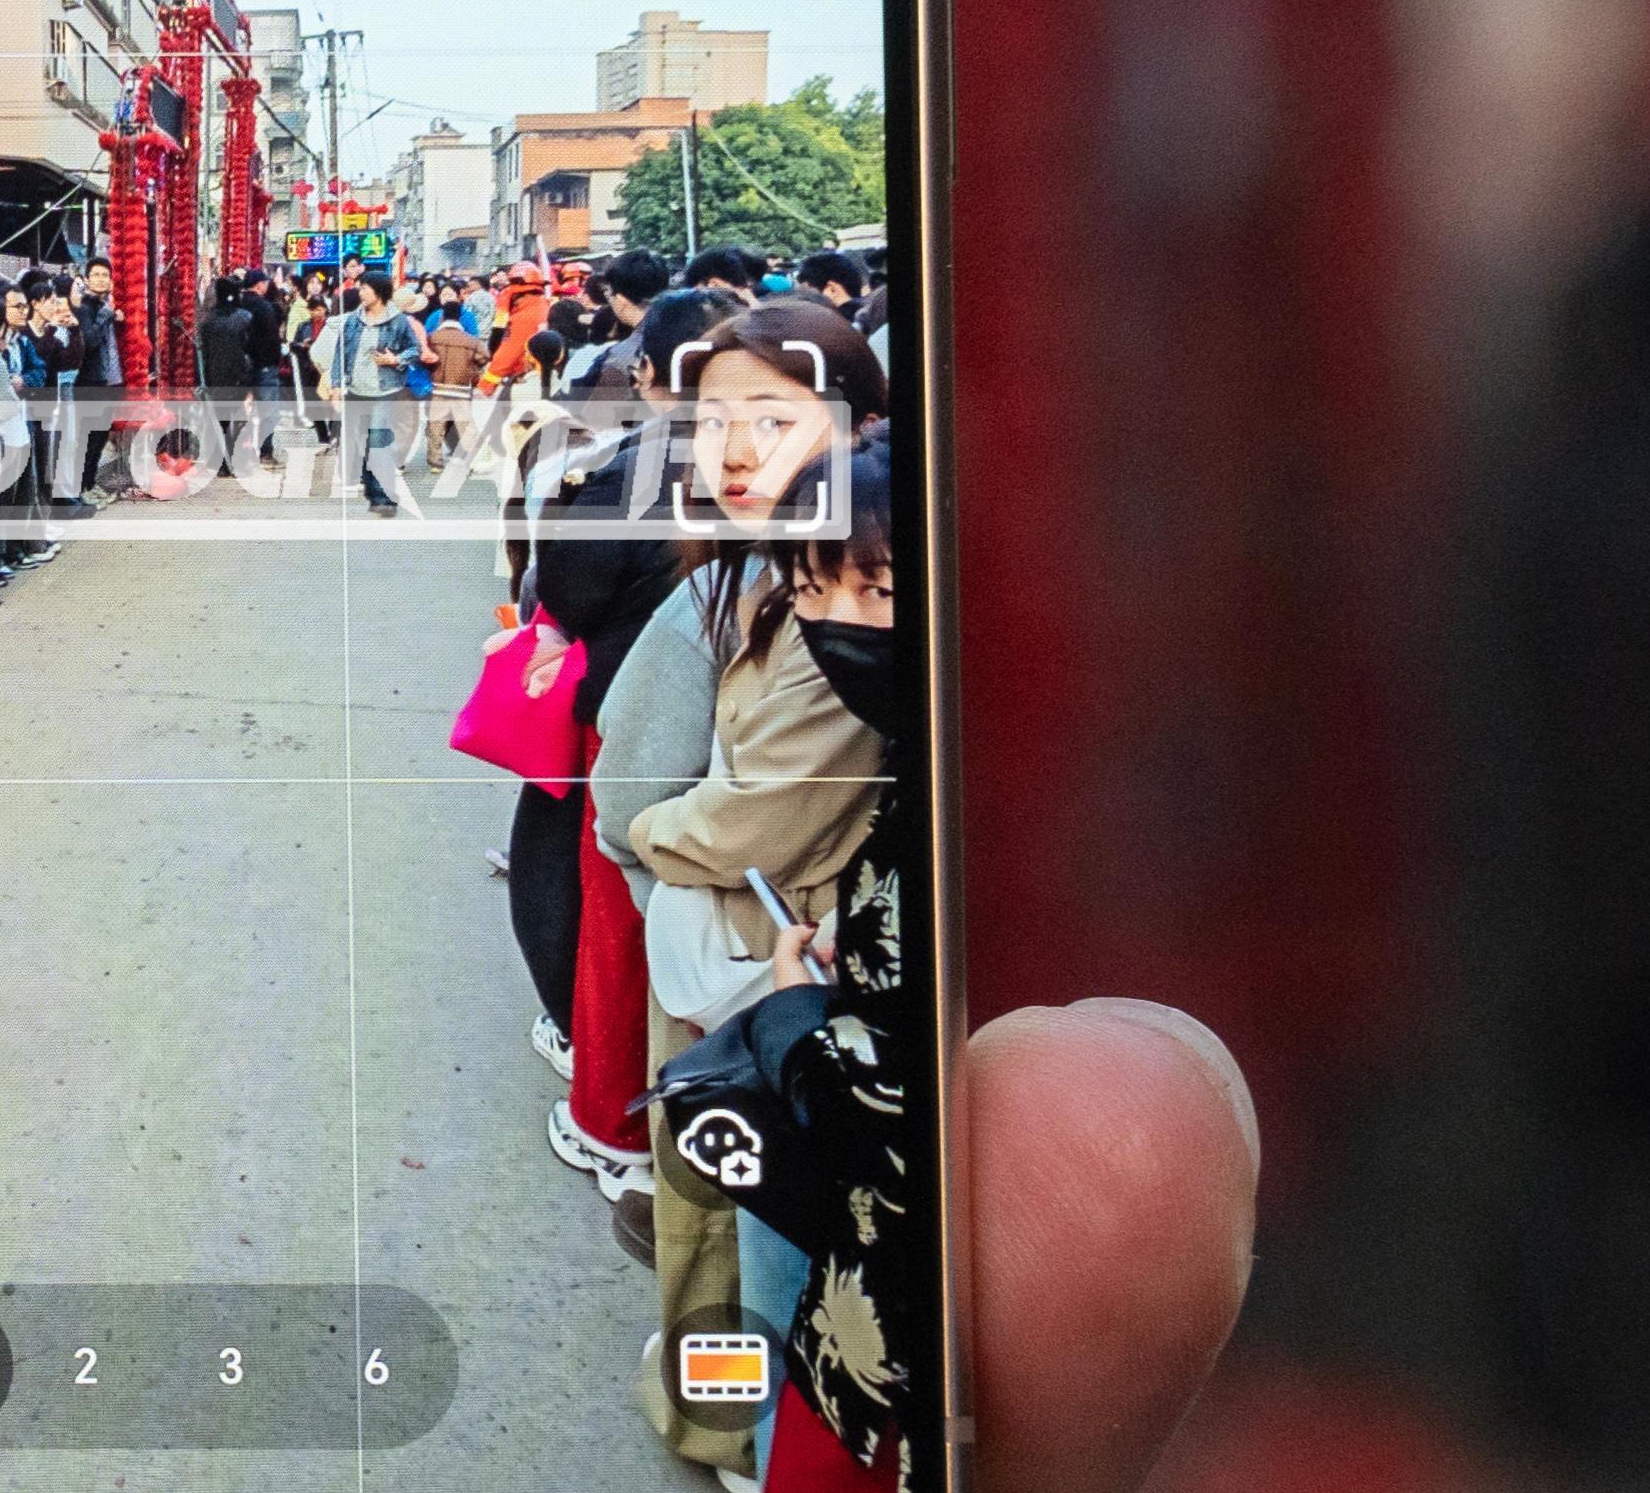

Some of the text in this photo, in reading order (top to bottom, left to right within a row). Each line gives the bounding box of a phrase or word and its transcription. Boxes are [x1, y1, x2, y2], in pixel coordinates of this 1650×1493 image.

[73, 1347, 98, 1385] 2
[219, 1347, 244, 1385] 3
[363, 1347, 390, 1385] 6
